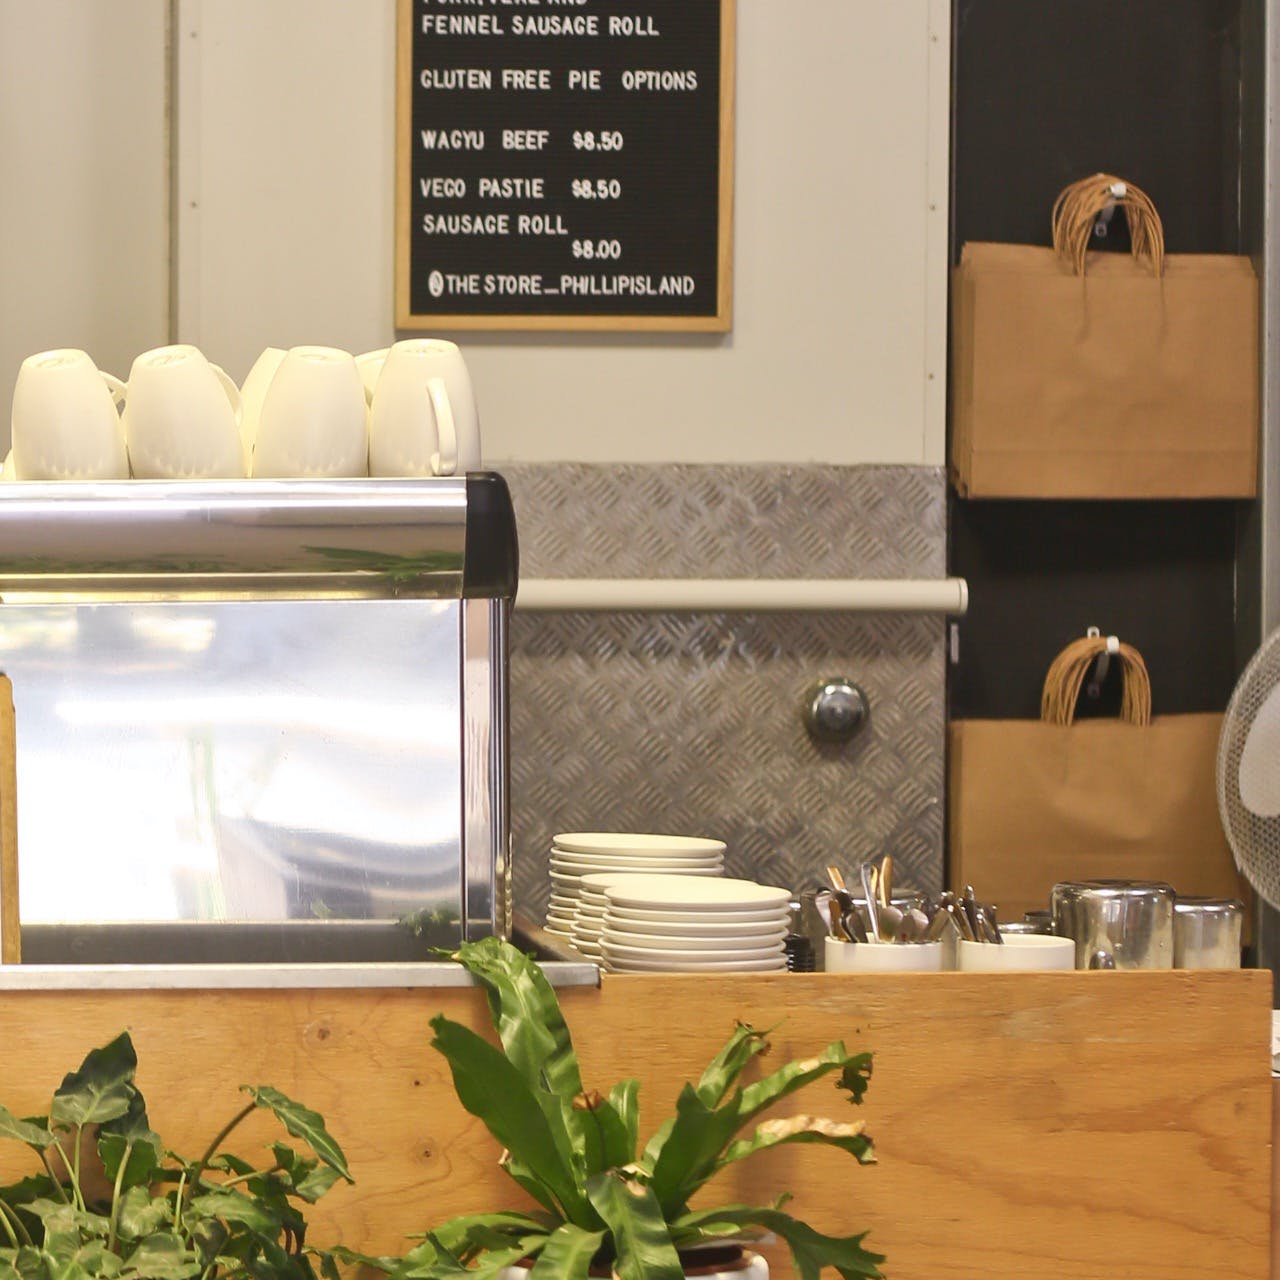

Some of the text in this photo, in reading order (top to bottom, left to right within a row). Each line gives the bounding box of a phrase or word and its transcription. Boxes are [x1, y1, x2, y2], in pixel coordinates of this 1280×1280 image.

[422, 14, 660, 36] FENNEL SAUSAGE ROLL
[420, 68, 698, 91] GLUTEN FREE PIE OPTIONS
[421, 129, 624, 151] WAGYU BEEF $8.50
[420, 177, 622, 200] VEGO PASTIE $8.50
[422, 214, 569, 235] SAUSAGE ROLL
[571, 239, 622, 260] $8.00
